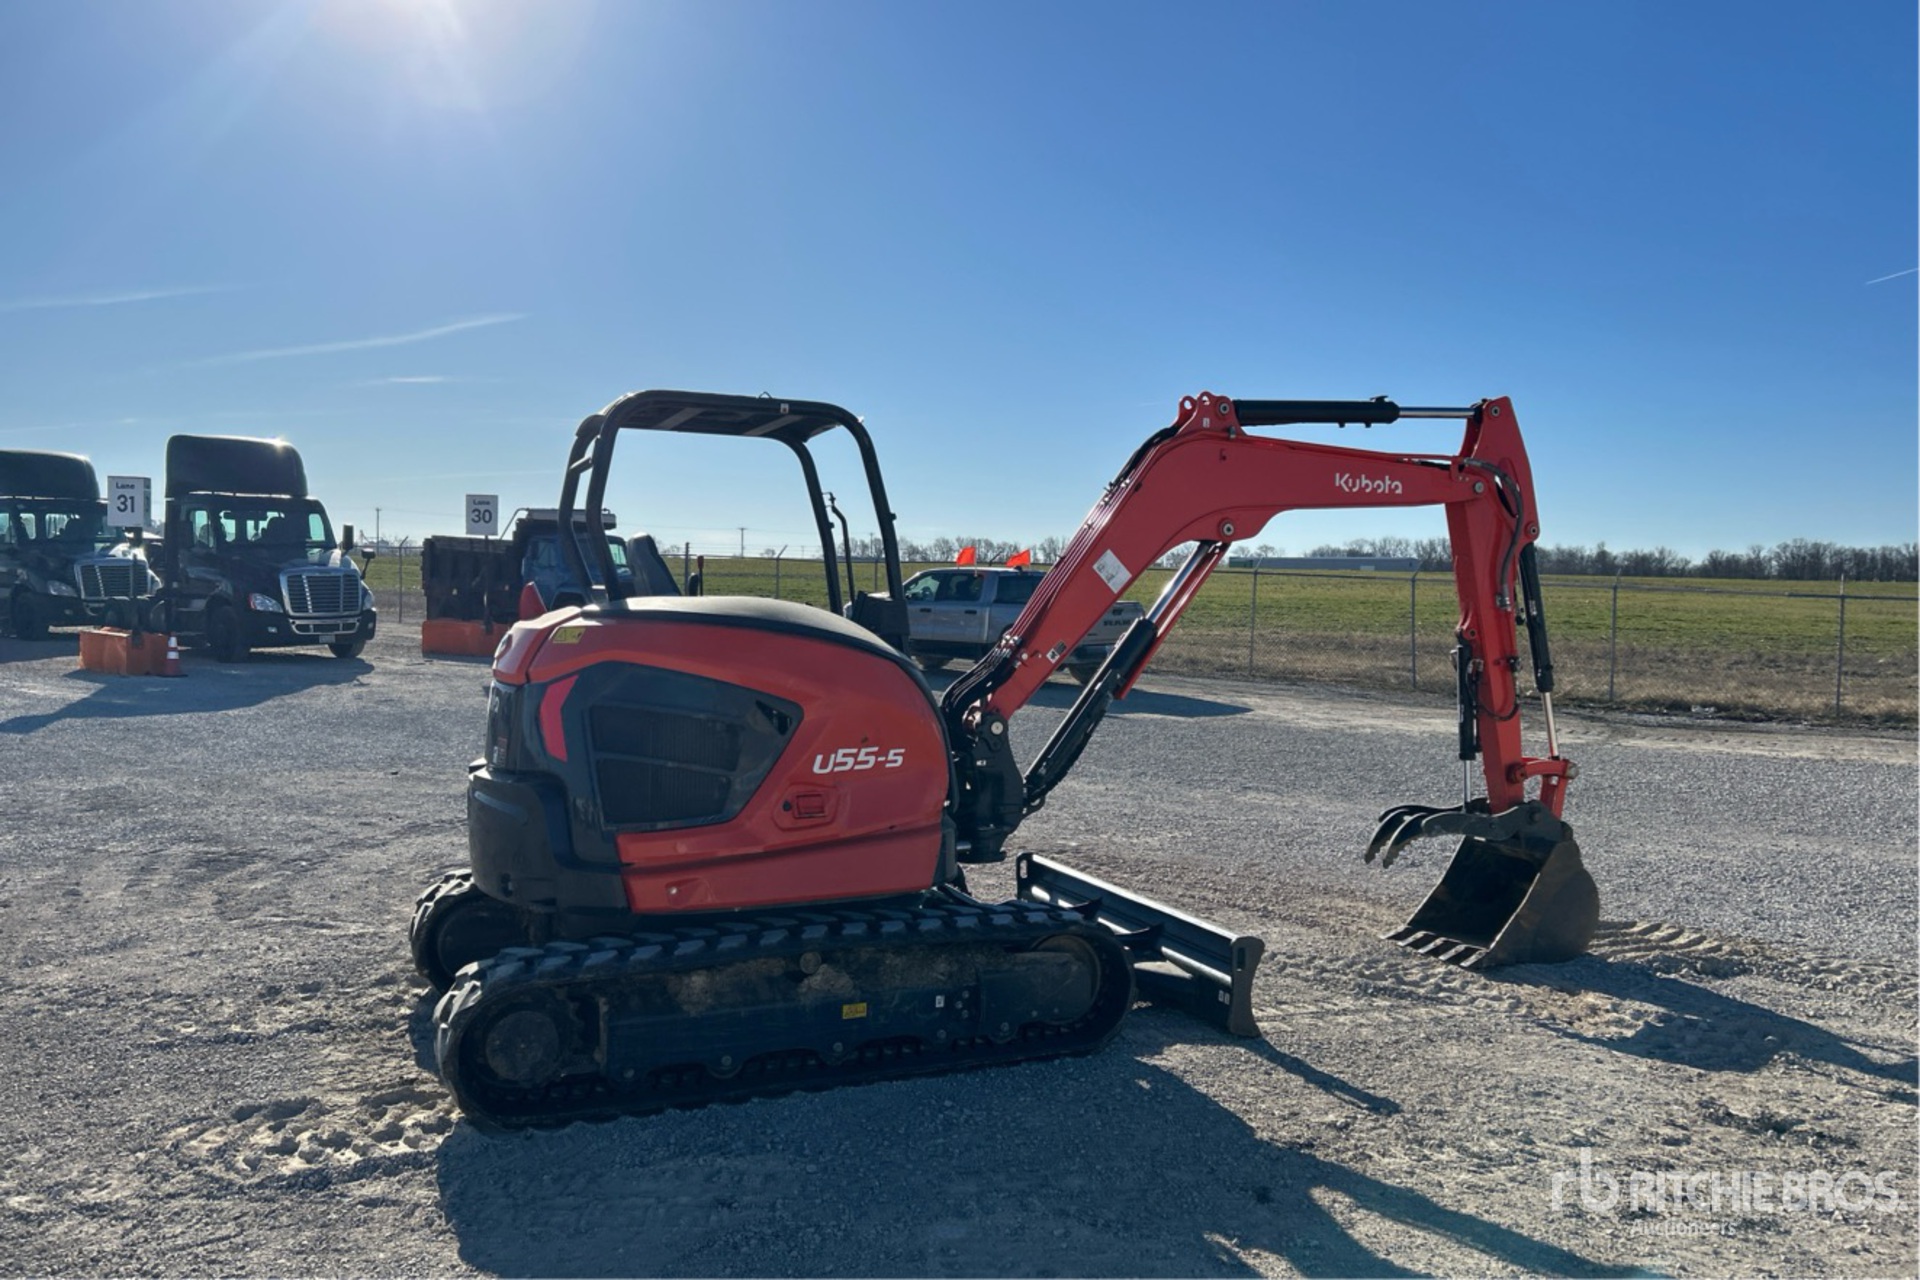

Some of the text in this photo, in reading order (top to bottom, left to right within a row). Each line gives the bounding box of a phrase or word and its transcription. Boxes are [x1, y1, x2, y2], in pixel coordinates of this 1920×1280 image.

[115, 481, 136, 490] Lane
[1335, 472, 1403, 495] Kubota
[116, 494, 135, 513] 31
[471, 508, 493, 524] 30
[812, 746, 906, 774] U55-5
